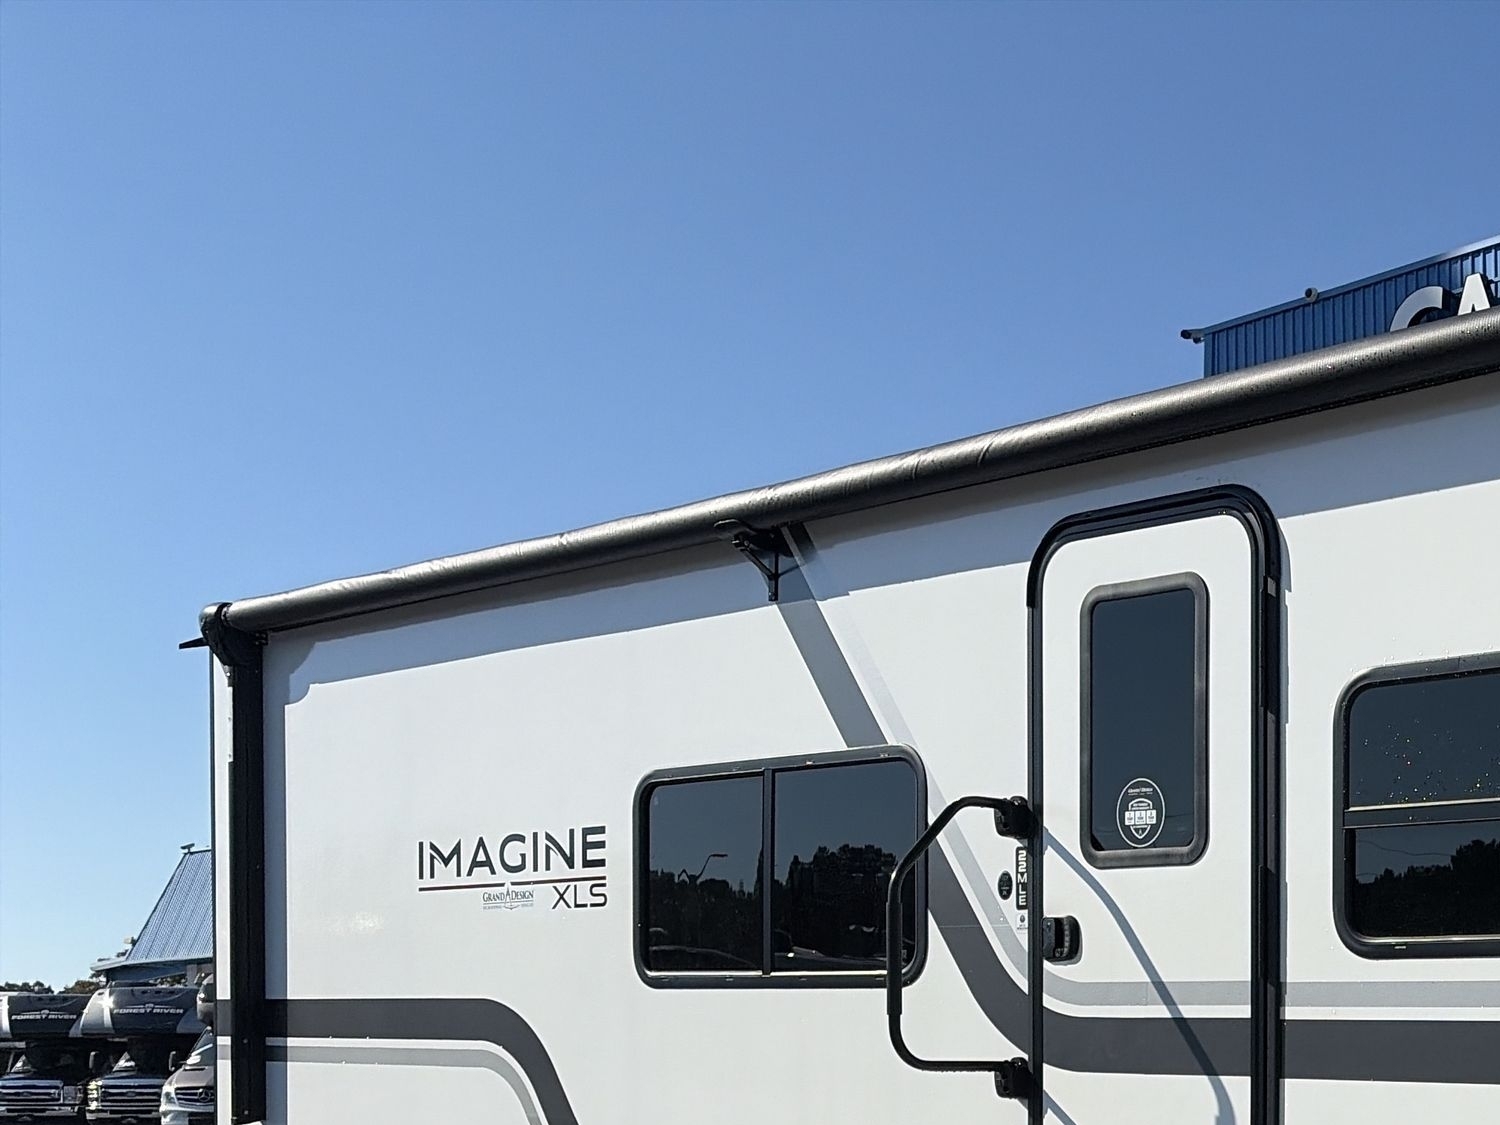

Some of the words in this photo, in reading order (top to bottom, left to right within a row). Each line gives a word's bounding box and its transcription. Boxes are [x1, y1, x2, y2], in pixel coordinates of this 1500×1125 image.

[418, 825, 606, 880] IMAGINE
[482, 891, 506, 902] GRAND
[510, 890, 534, 900] DESIGN
[551, 882, 608, 910] XLS
[1017, 849, 1028, 906] 22MLE
